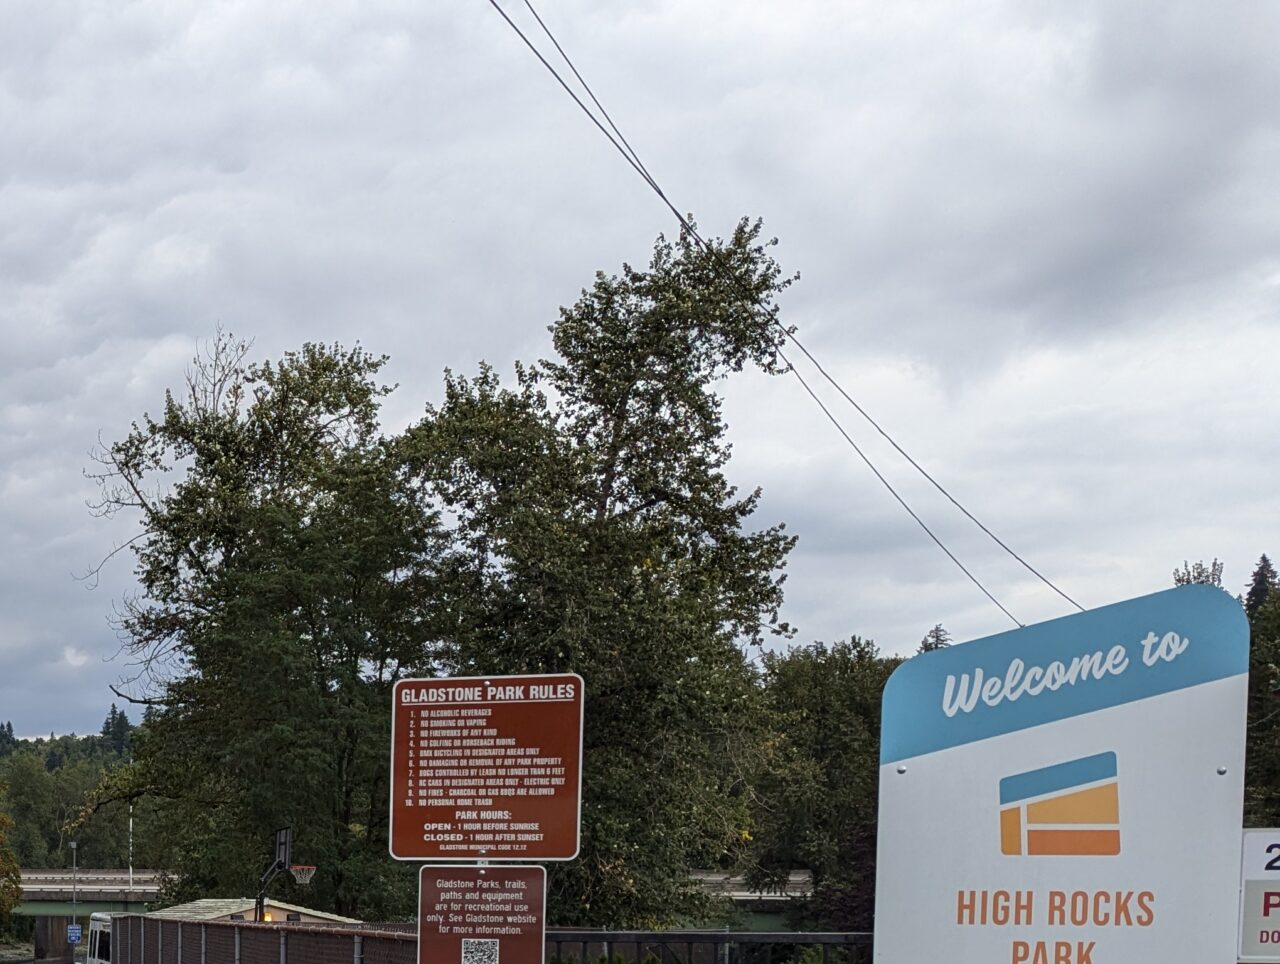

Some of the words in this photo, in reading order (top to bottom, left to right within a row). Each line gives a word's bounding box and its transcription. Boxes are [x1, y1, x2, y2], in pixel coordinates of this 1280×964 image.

[942, 643, 1130, 717] Welcome
[1140, 631, 1189, 668] to
[401, 687, 482, 702] GLADSTONE
[488, 686, 526, 700] PARK
[530, 684, 575, 699] RULES
[430, 729, 460, 737] FIREWORKS
[496, 738, 516, 746] RIDING
[472, 748, 505, 756] DESIGNATED
[456, 811, 478, 819] PARK
[480, 811, 512, 819] HOURS:
[437, 879, 474, 888] Gladstone
[440, 892, 462, 901] paths
[482, 892, 523, 902] equipment
[465, 903, 511, 911] recreational
[956, 890, 1033, 926] HIGH
[1047, 890, 1155, 927] ROCKS
[427, 914, 445, 924] only.
[449, 914, 462, 922] See
[466, 914, 503, 922] Gladstone
[507, 915, 536, 923] website
[439, 925, 449, 933] for
[476, 925, 523, 935] information.
